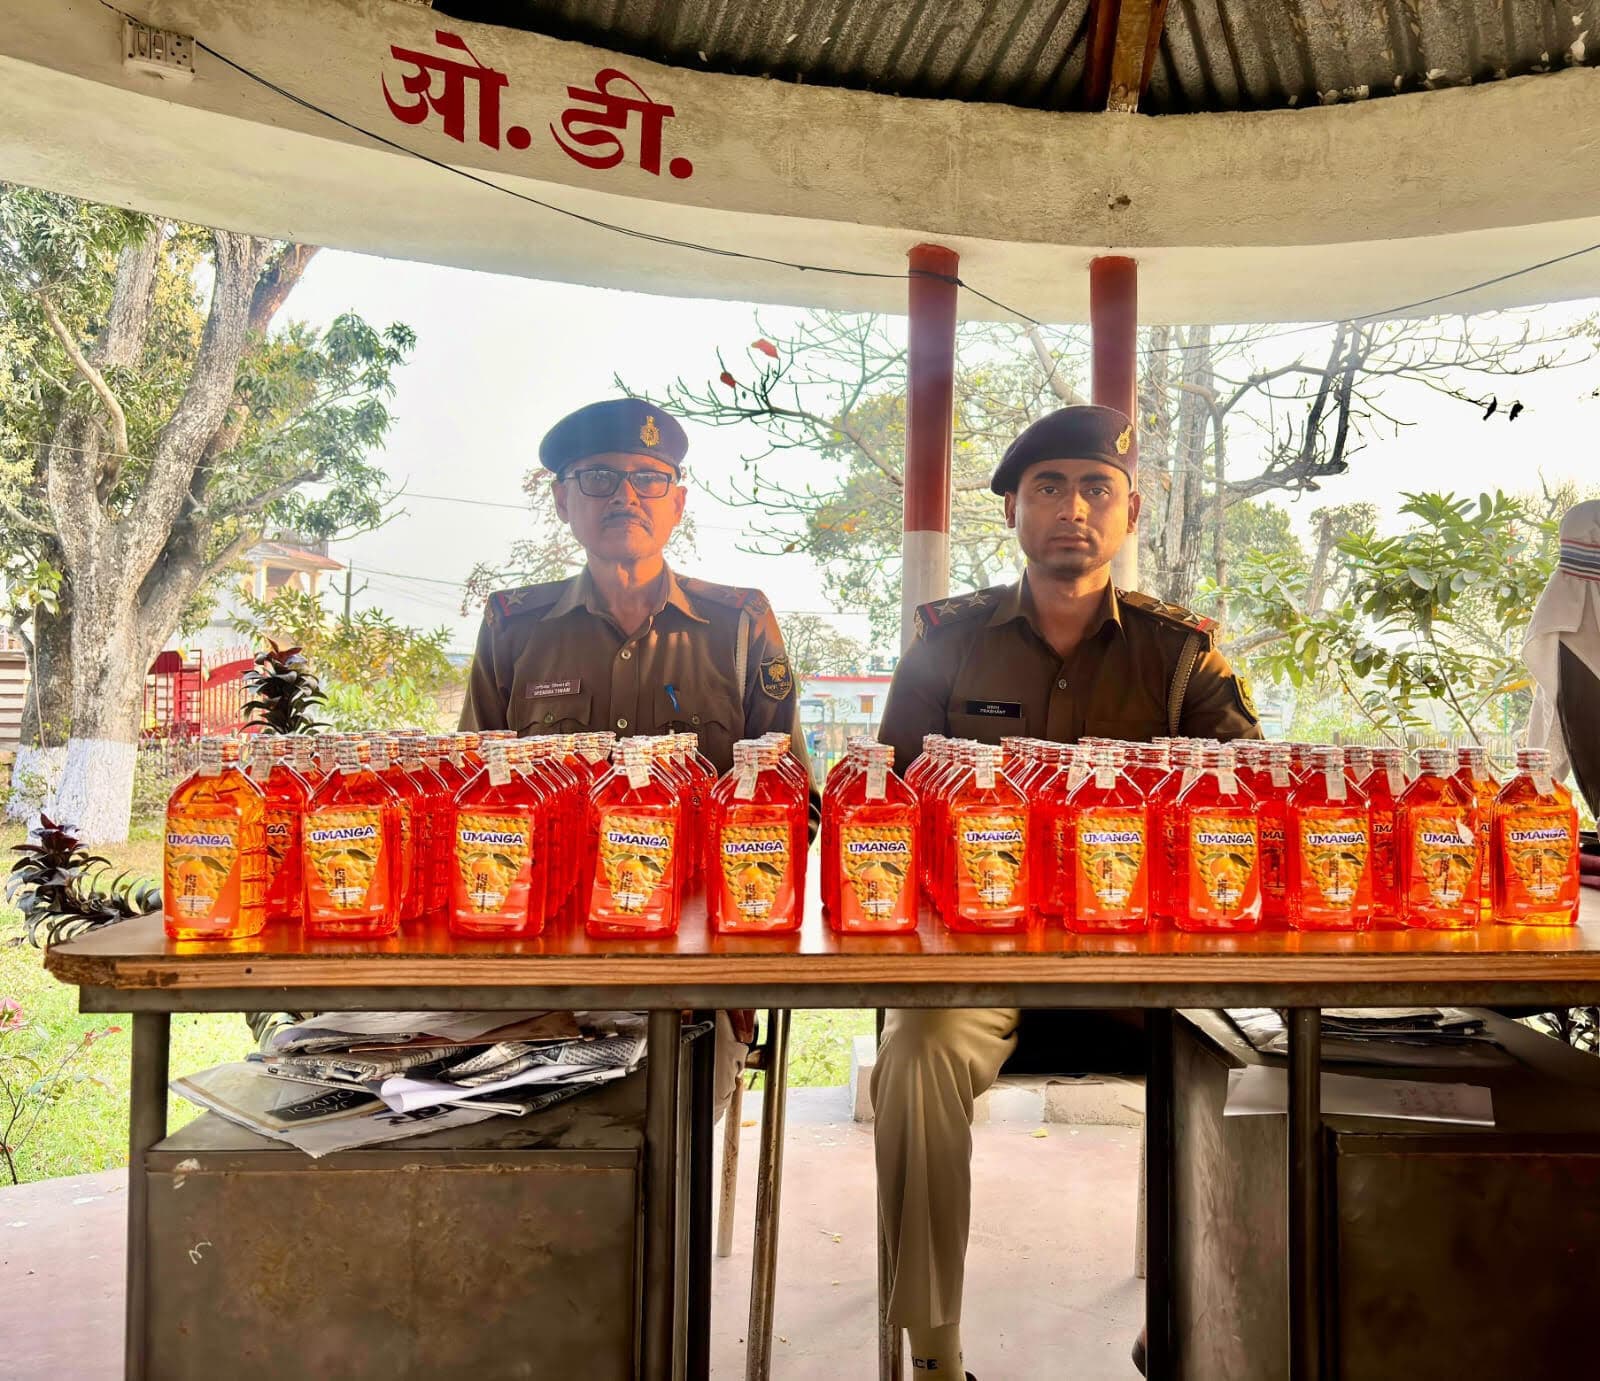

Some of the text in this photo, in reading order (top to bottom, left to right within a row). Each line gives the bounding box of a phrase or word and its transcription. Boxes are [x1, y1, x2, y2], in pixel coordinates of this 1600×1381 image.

[381, 29, 693, 179] ओ. डी.
[167, 834, 231, 845] UMANGA
[312, 826, 374, 841] UMANGA
[462, 831, 523, 844] UMANGA
[608, 832, 669, 847] UMANGA
[966, 830, 1021, 842] UMANGA
[1083, 832, 1140, 843] UMANGA
[1198, 833, 1253, 844] UMANGA
[1308, 833, 1364, 844] UMANGA
[1423, 833, 1474, 844] UMAN
[1511, 828, 1567, 841] UMANGA
[725, 841, 783, 853] UMANGA
[849, 842, 907, 853] UMANGA
[912, 1356, 938, 1370] ICE
